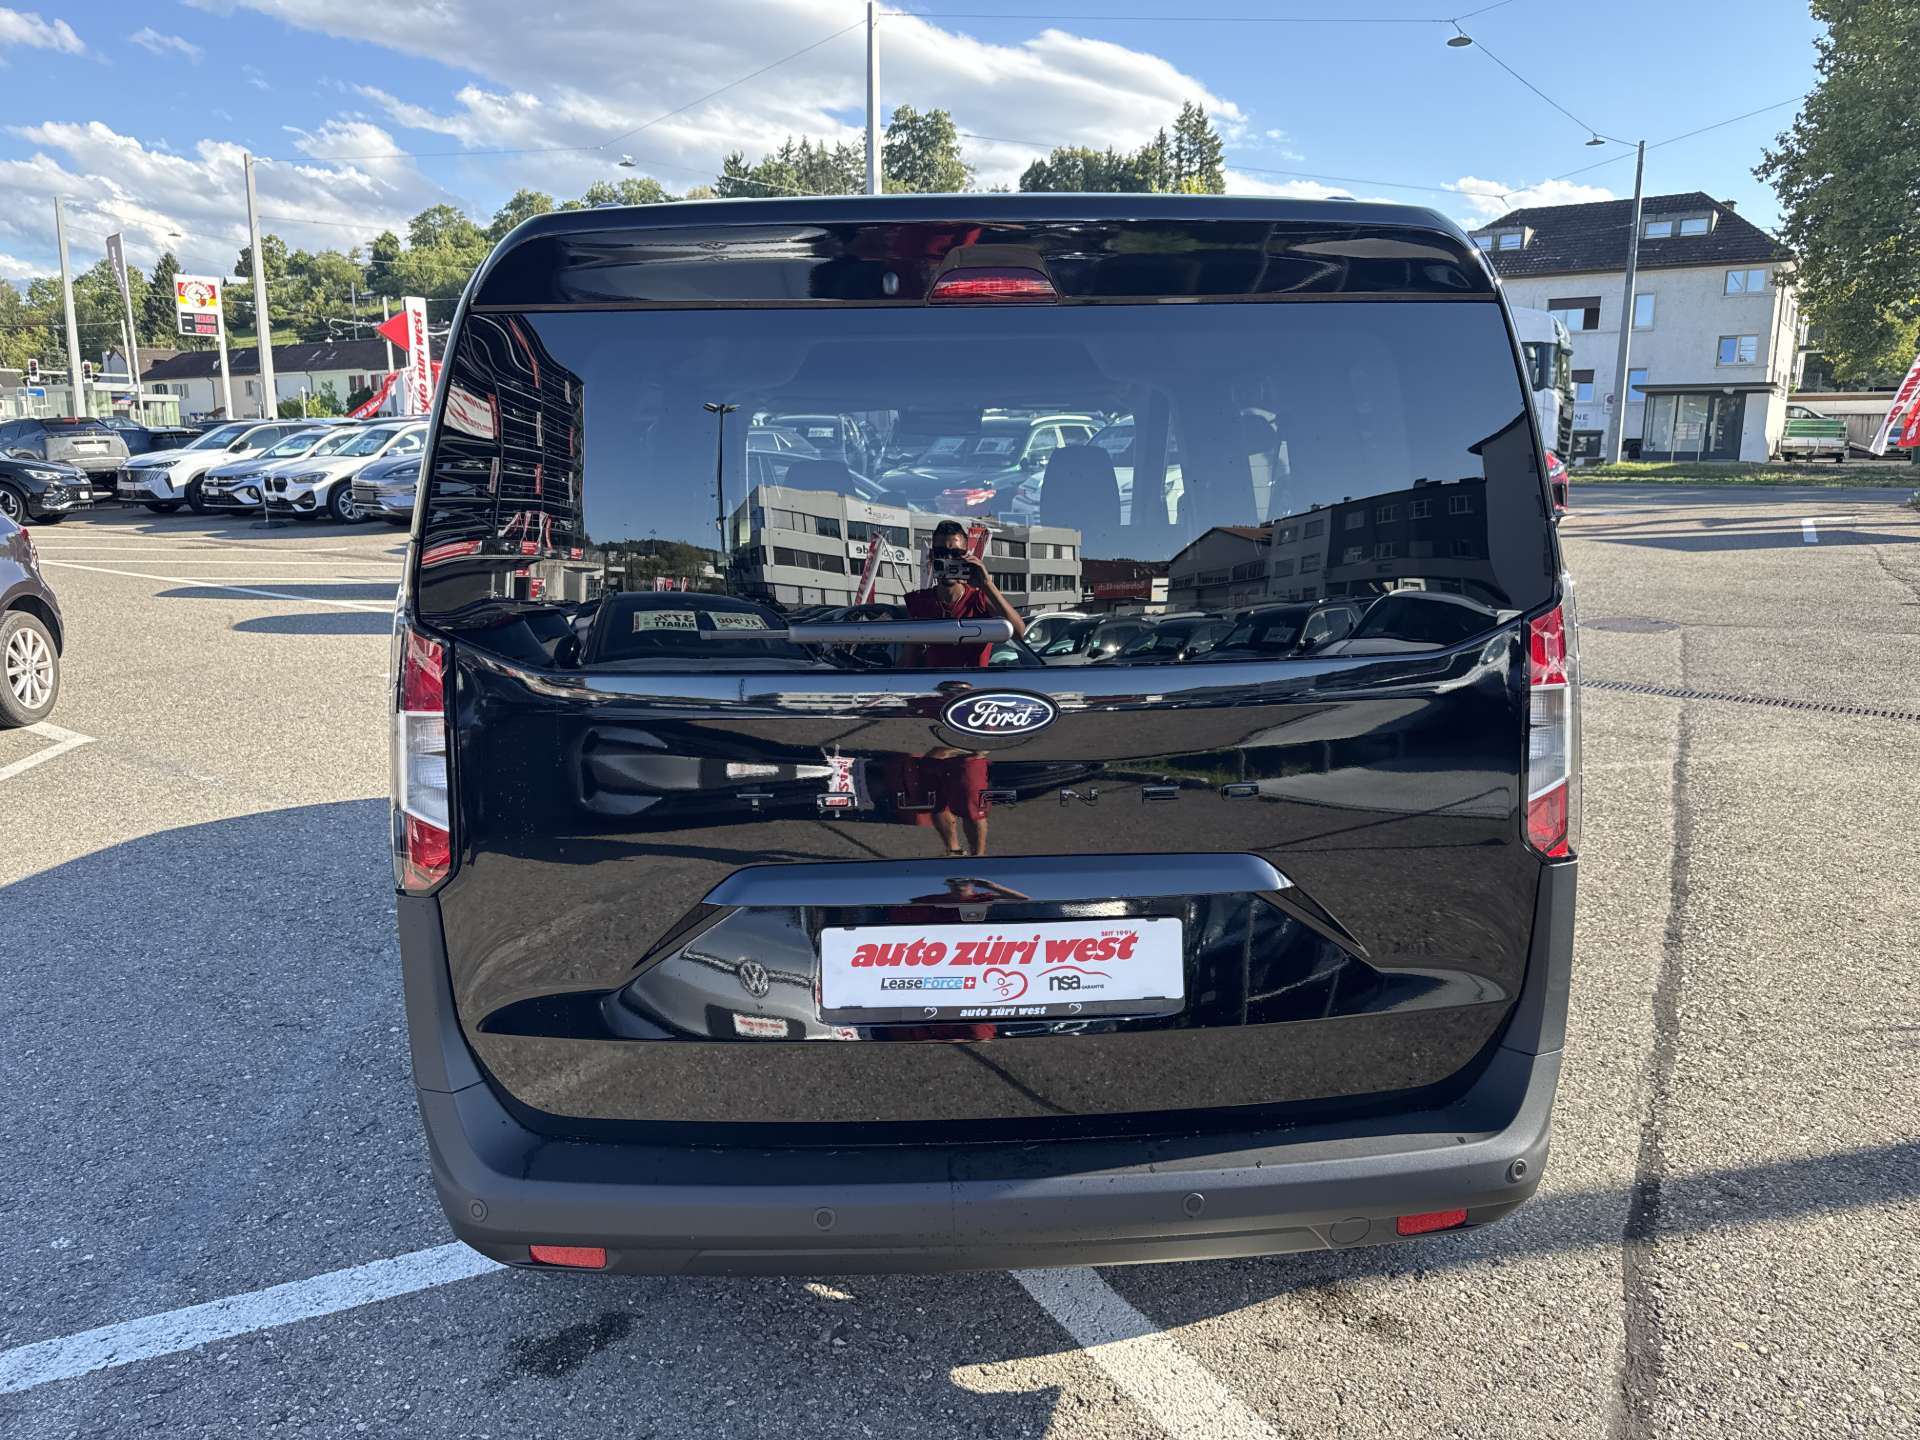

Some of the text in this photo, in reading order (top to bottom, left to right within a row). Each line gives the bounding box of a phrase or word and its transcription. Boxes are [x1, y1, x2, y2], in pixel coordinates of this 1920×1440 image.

[967, 700, 1032, 727] Ford
[851, 930, 1139, 967] auto züri west
[881, 976, 963, 990] LeaseForce
[1049, 974, 1081, 991] nsa
[960, 1005, 1047, 1017] auto züri west
